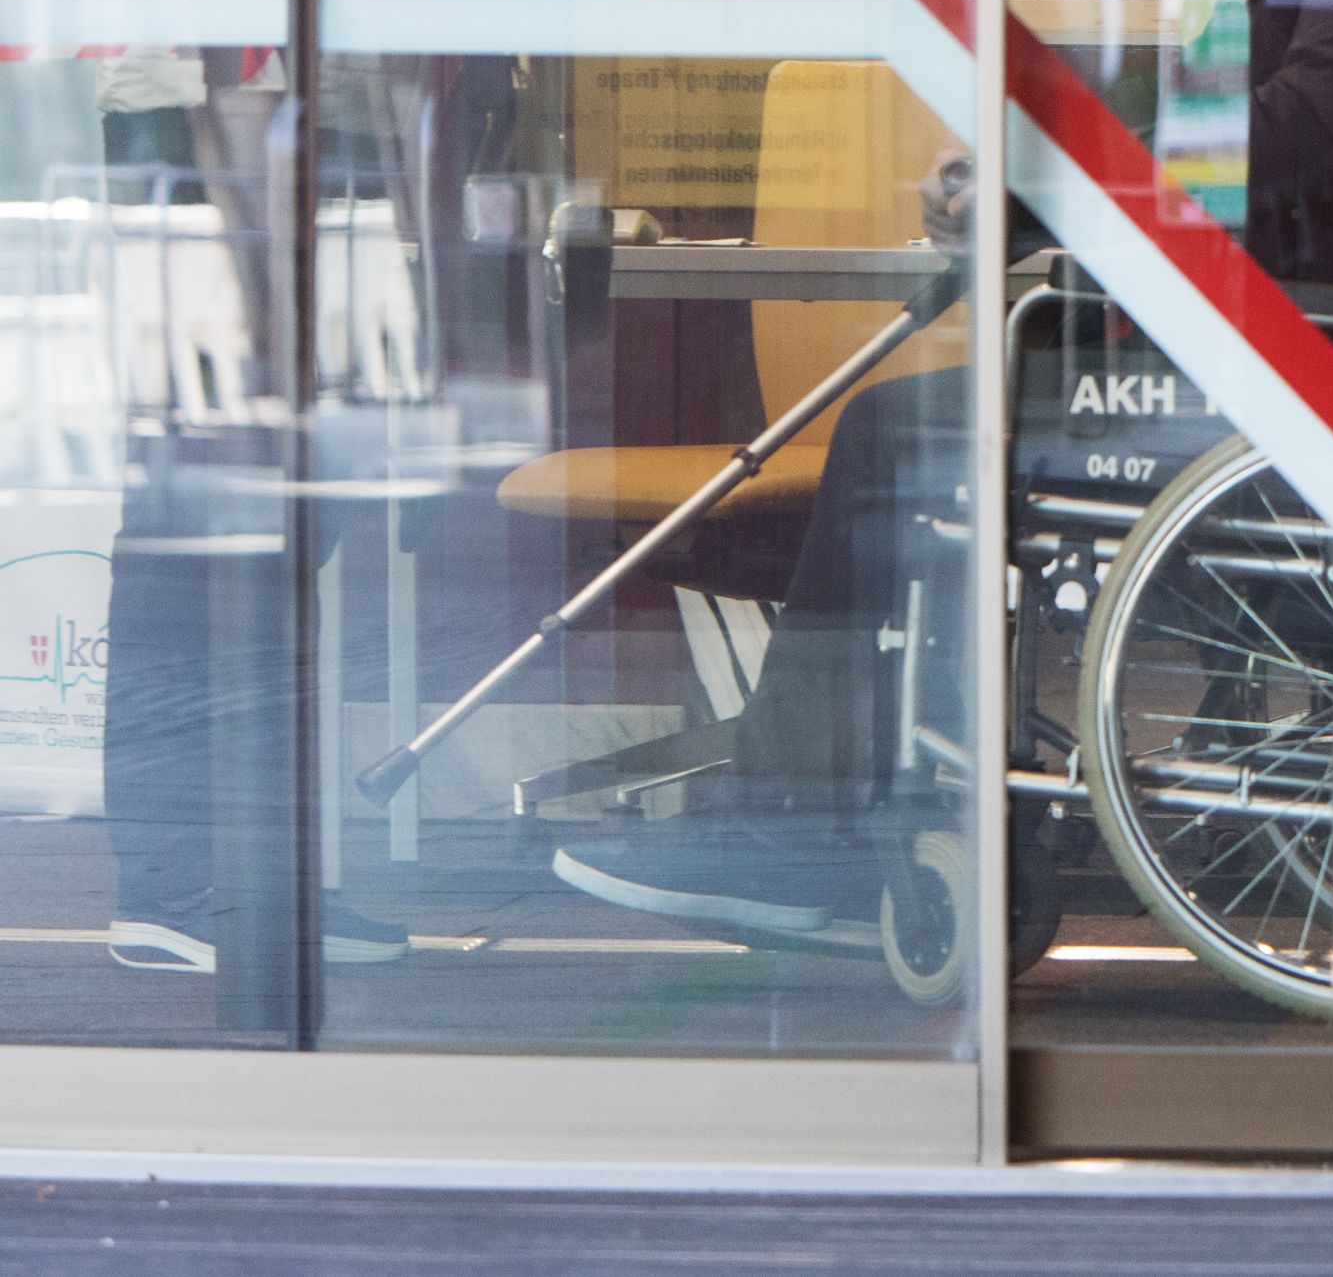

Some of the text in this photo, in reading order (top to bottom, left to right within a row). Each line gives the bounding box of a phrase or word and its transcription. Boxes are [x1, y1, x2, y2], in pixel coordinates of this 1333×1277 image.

[1069, 375, 1176, 415] AKH
[1086, 453, 1157, 482] 04 07
